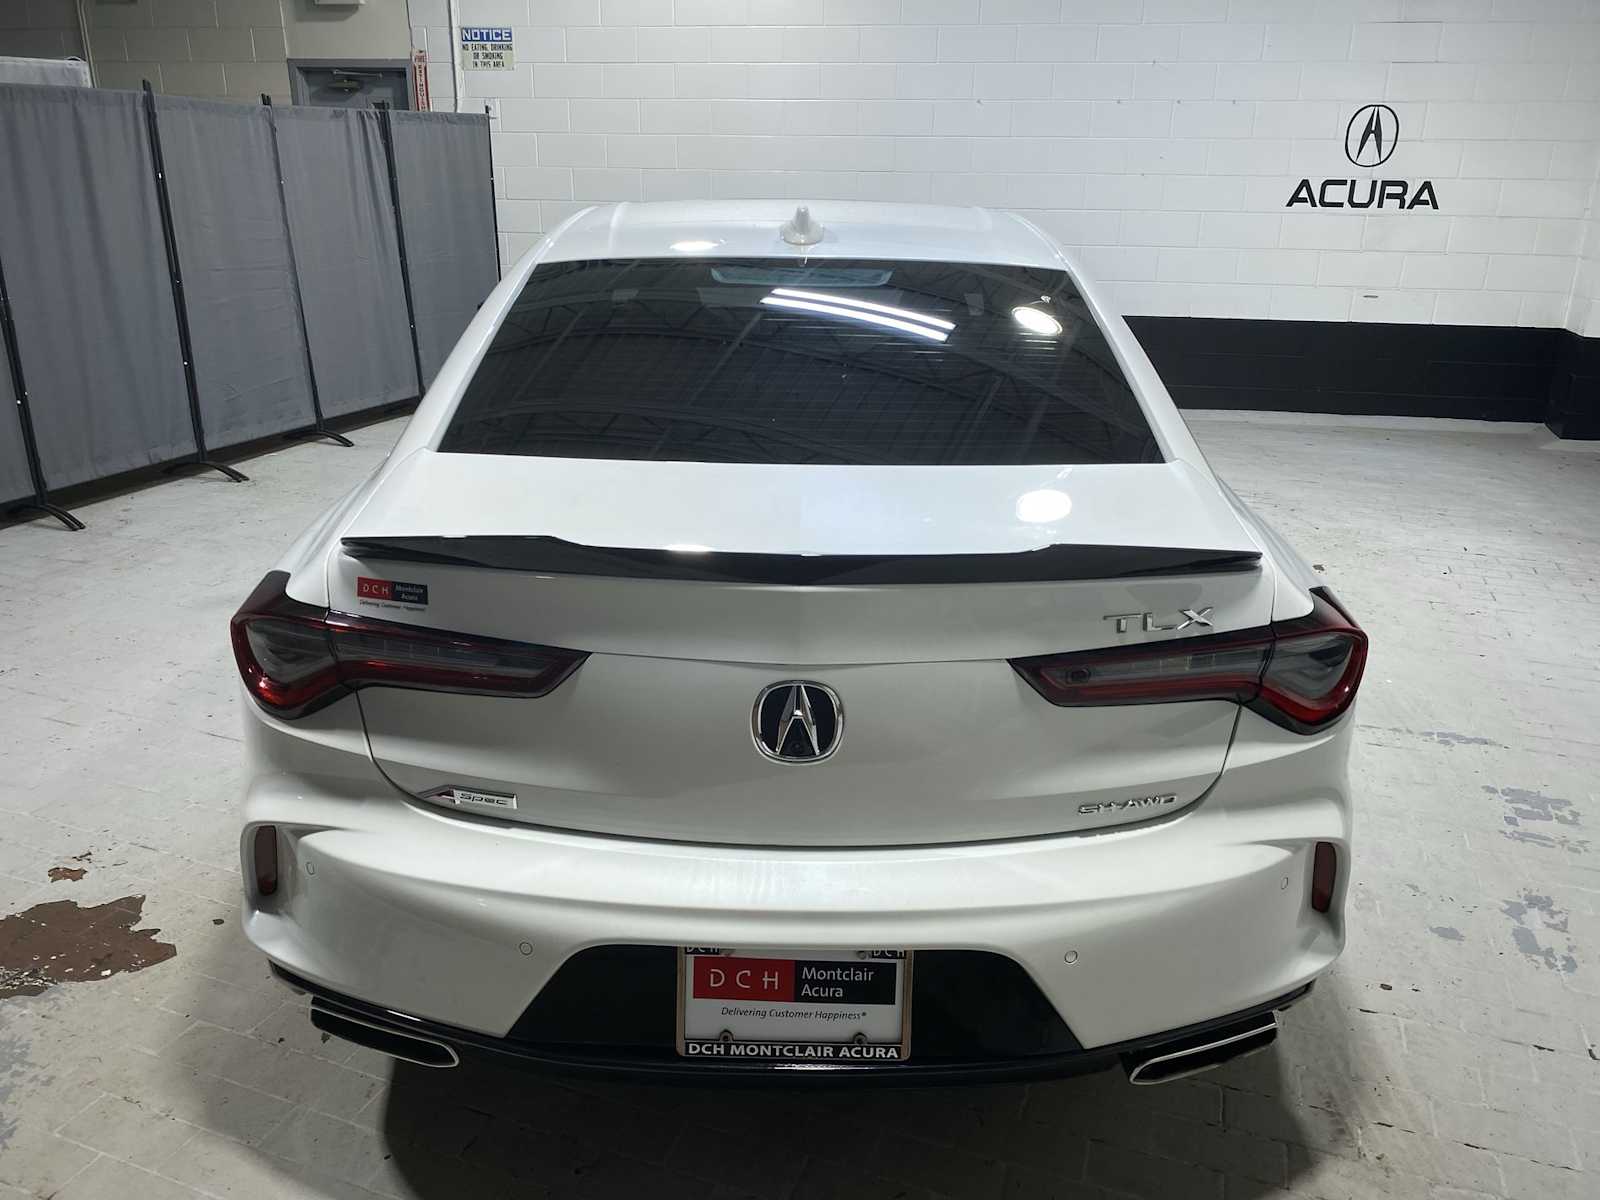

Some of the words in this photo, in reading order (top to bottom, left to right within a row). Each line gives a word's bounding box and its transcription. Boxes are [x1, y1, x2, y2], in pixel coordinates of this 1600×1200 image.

[462, 29, 512, 41] NOTICE
[473, 52, 480, 60] OR
[482, 52, 504, 60] SMOKING
[1286, 179, 1439, 210] ACURA
[1103, 607, 1213, 634] TLX
[1078, 793, 1177, 815] SH-AWD
[801, 967, 875, 983] Montclair
[800, 984, 844, 998] Acura
[721, 1006, 767, 1019] Delivering
[769, 1009, 813, 1019] Customer
[688, 1043, 725, 1055] DCH
[729, 1044, 834, 1057] MONTCLAIR
[838, 1046, 899, 1059] ACURA
